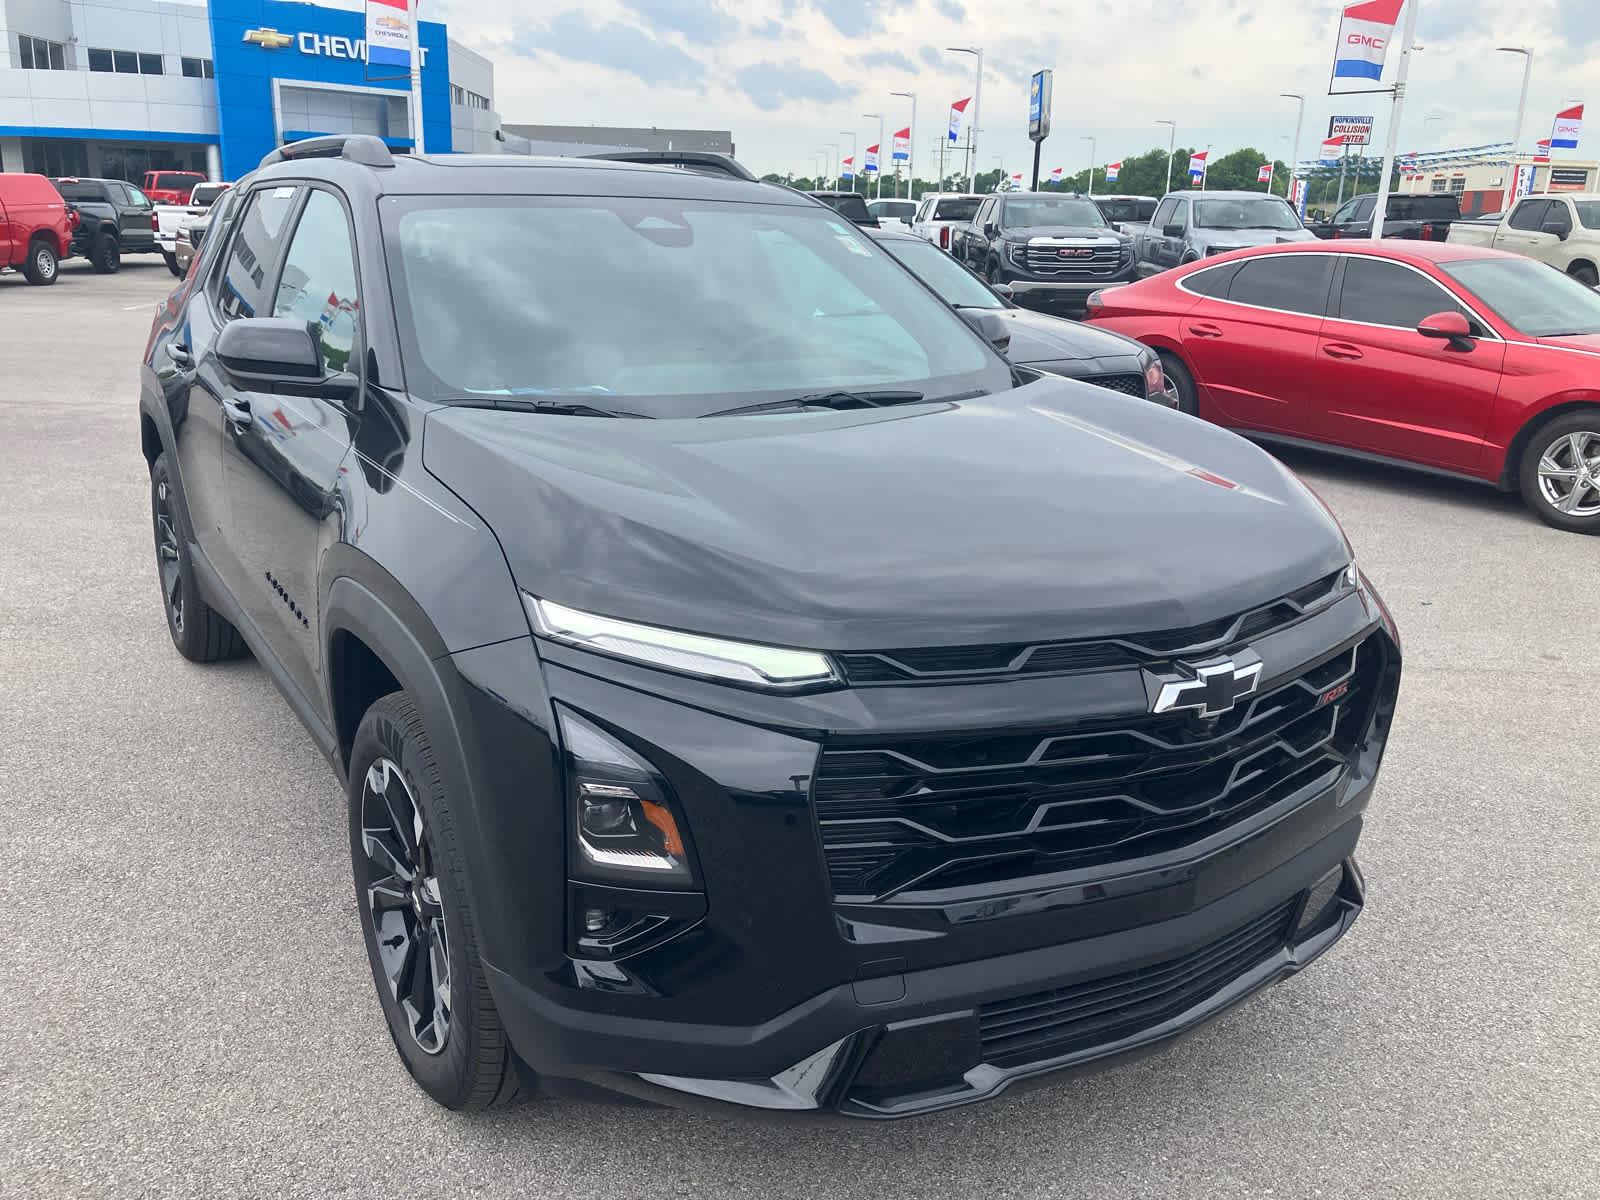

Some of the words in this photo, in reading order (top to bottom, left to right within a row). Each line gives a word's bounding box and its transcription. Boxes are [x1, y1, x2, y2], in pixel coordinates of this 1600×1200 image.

[374, 29, 408, 39] CHEVROLE
[1347, 33, 1385, 49] GMC
[298, 31, 429, 67] CHEVT
[1333, 124, 1371, 134] COLLISION
[1342, 134, 1365, 142] ENTER
